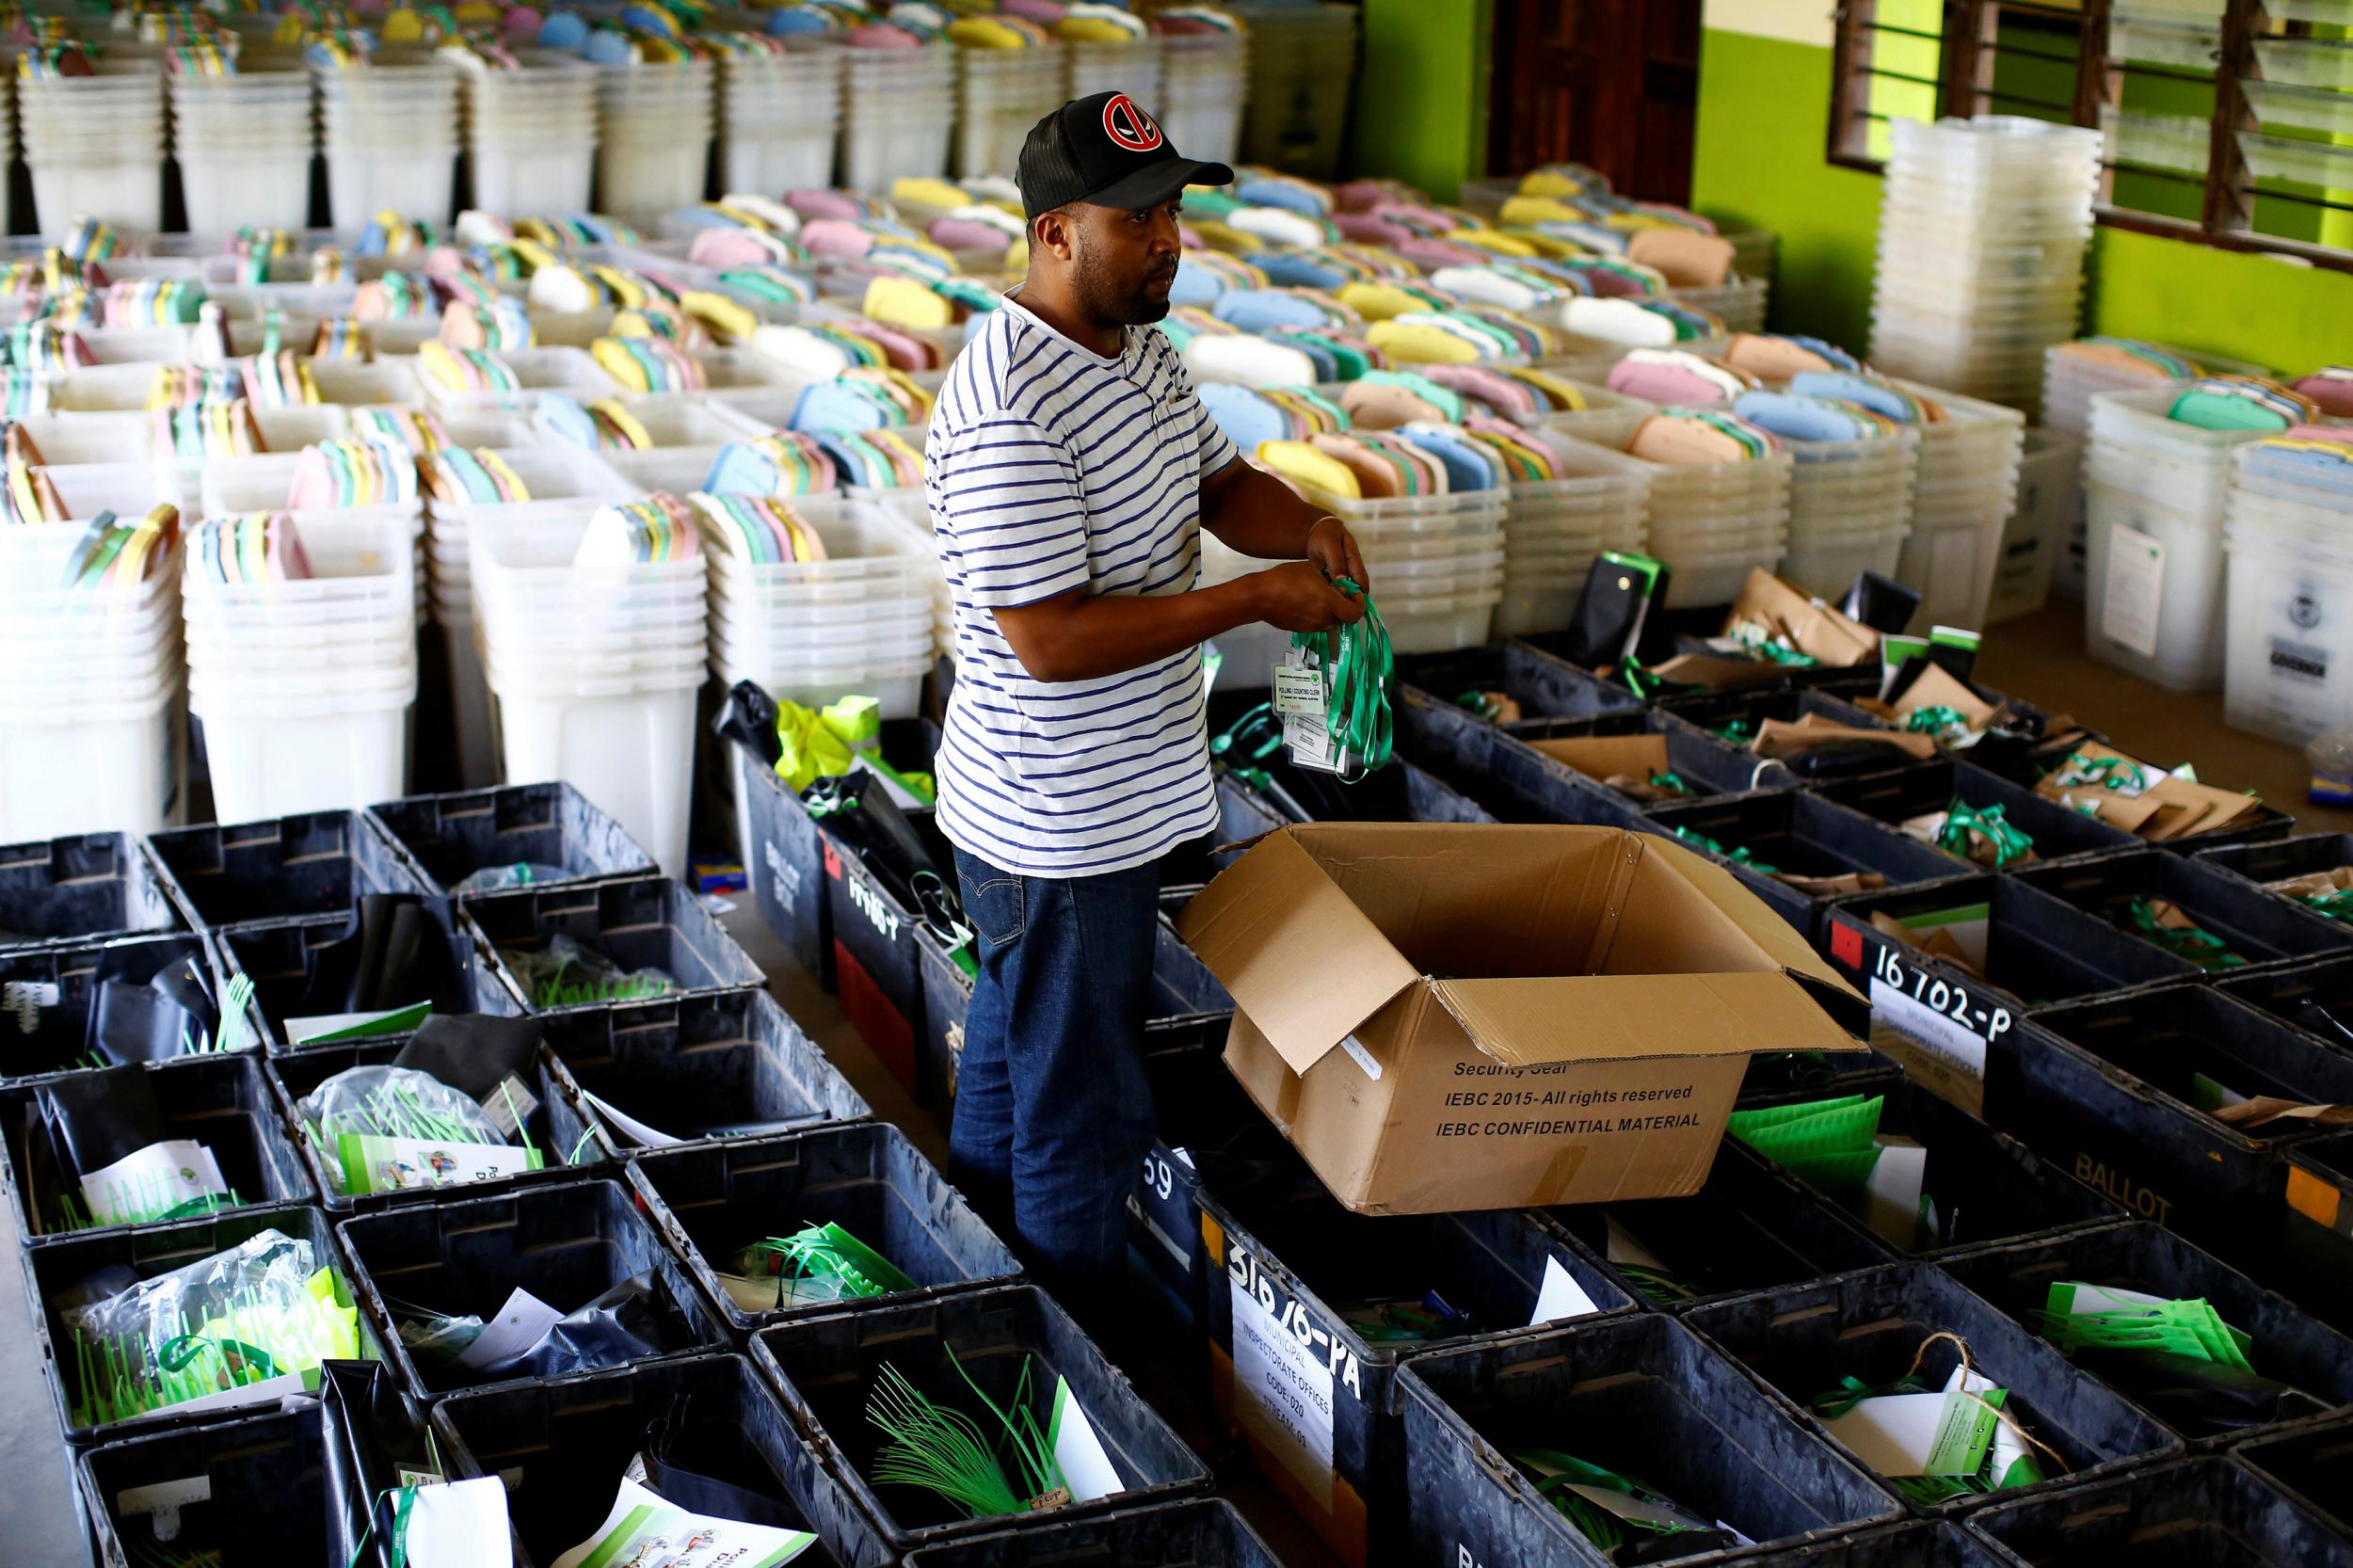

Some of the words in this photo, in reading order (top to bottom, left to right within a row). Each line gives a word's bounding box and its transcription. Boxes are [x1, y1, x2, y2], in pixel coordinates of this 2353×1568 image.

[1445, 1092, 1489, 1106] IEBC
[1542, 1090, 1565, 1105] All
[1569, 1088, 1617, 1107] rights
[1621, 1085, 1693, 1102] reserved
[1436, 1123, 1481, 1137] IEBC
[1483, 1119, 1614, 1136] CONFIDENTIAL
[1618, 1113, 1701, 1131] MATERIAL
[2075, 1152, 2171, 1225] BALLOT
[1242, 1321, 1296, 1384] INSPECTORATE
[1299, 1377, 1329, 1415] OFFICES
[1263, 1318, 1305, 1368] MUNICIPAL
[1266, 1372, 1289, 1403] CODE:
[1290, 1396, 1305, 1417] 020
[1262, 1395, 1295, 1437] STREAM:
[1296, 1431, 1306, 1448] 01
